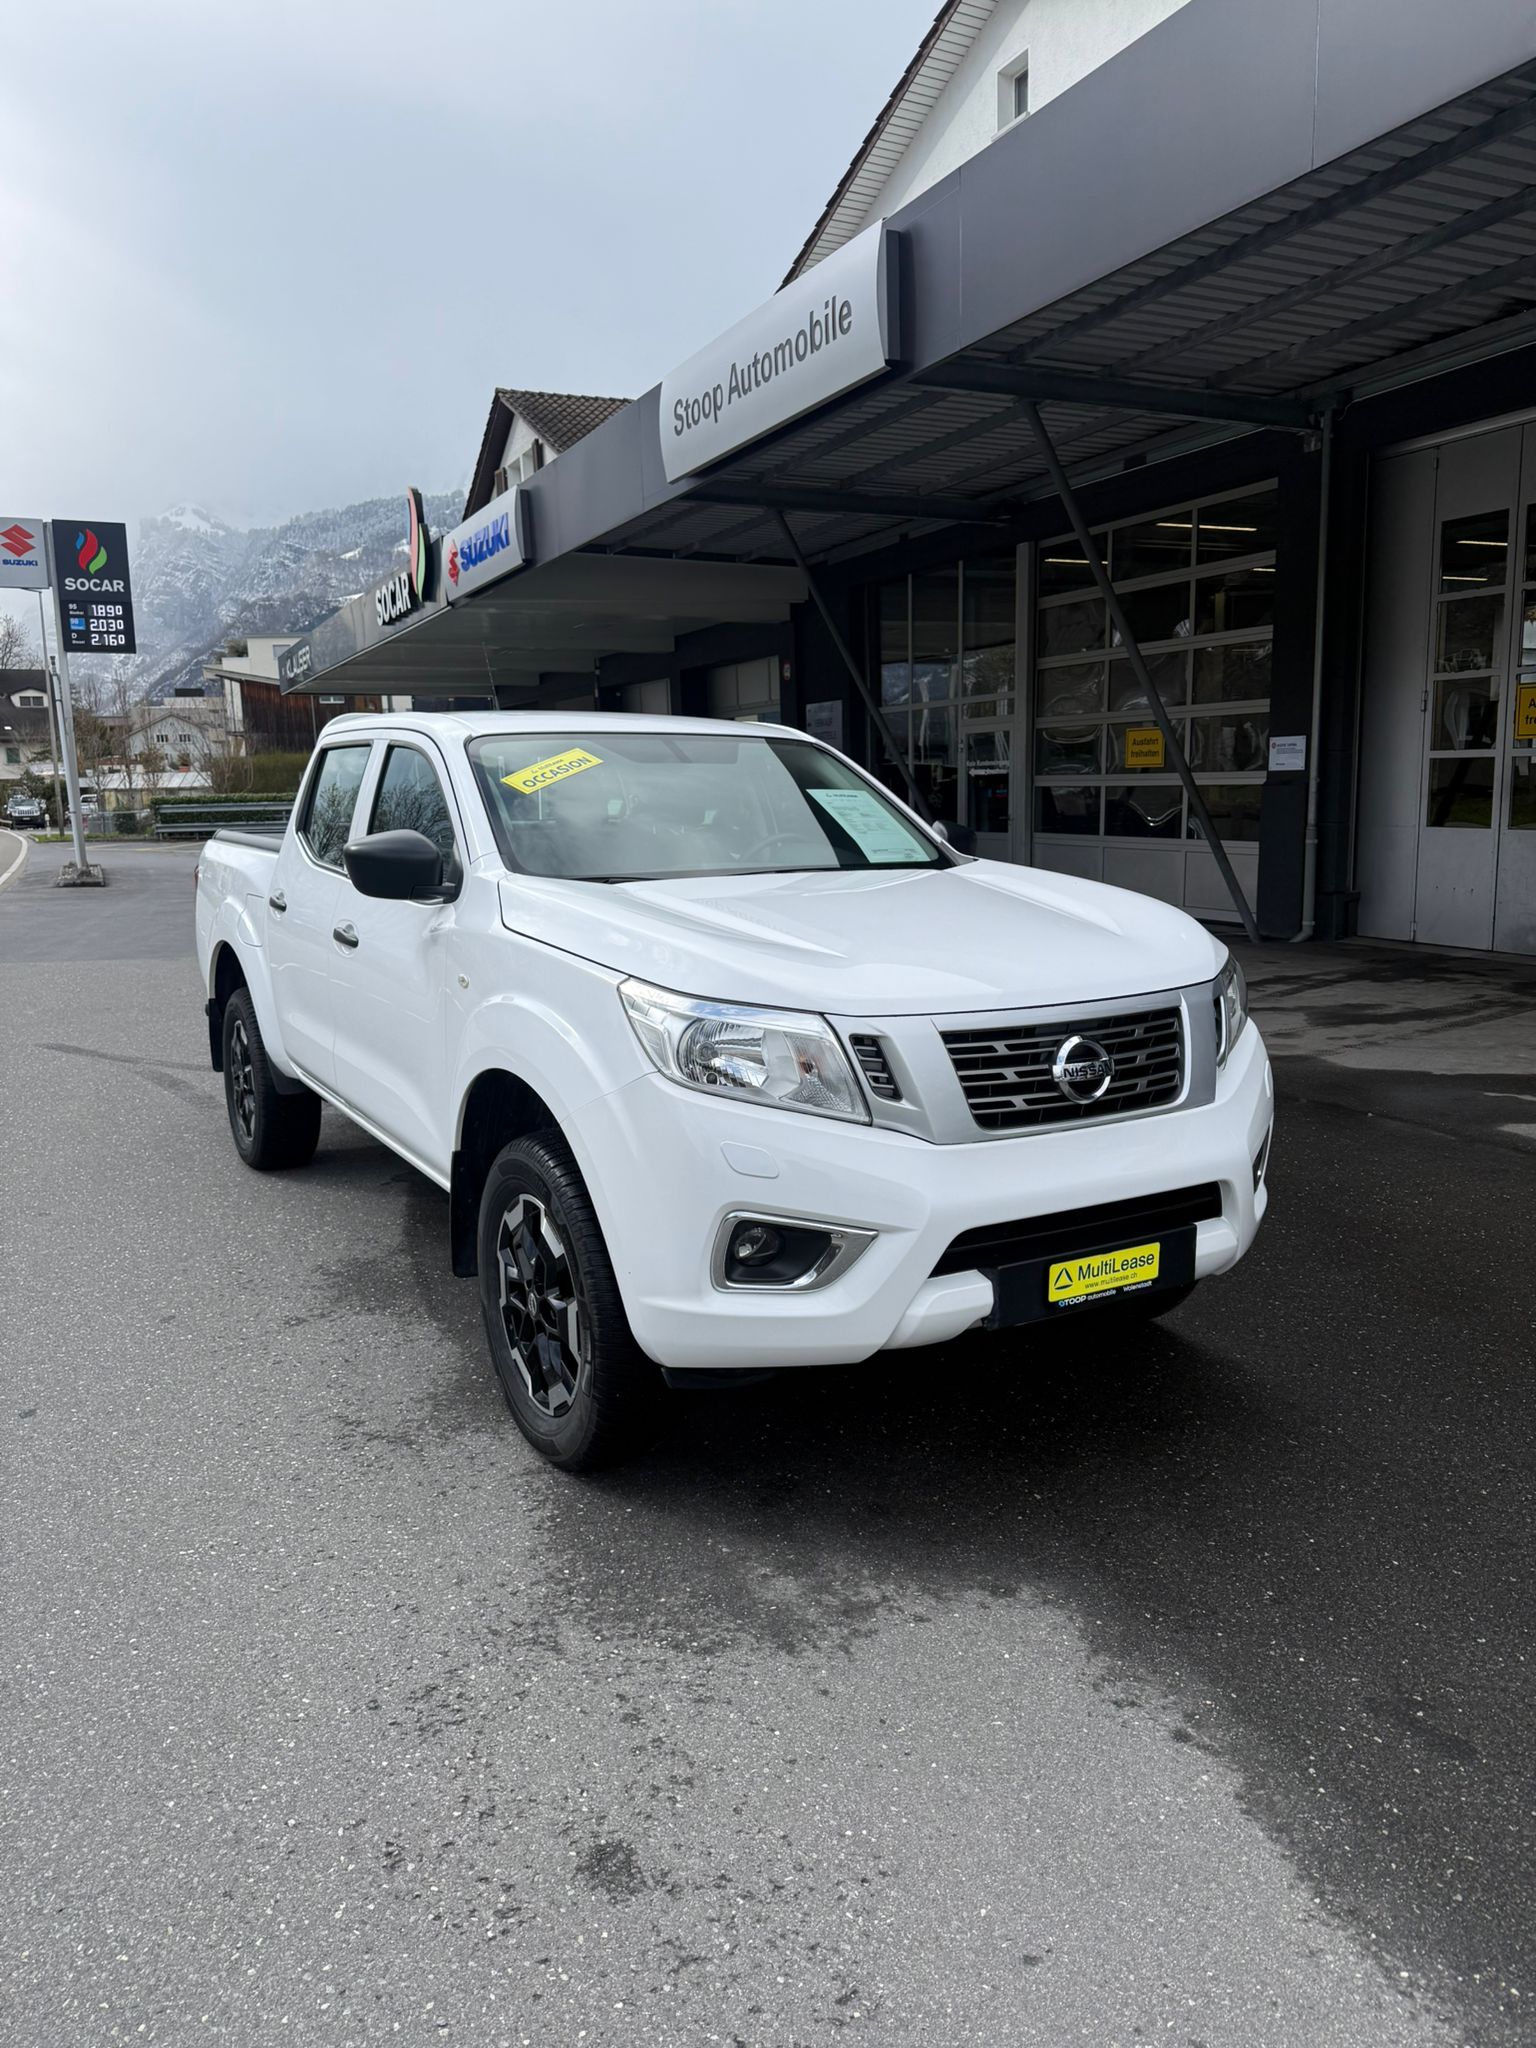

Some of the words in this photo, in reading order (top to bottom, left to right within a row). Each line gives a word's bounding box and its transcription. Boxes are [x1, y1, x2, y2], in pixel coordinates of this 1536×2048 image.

[673, 383, 724, 437] Stoop
[727, 295, 853, 406] Automobile
[460, 512, 510, 573] SUZUKI
[2, 559, 38, 567] SUZUKI
[64, 577, 125, 592] SOCAR
[375, 571, 412, 627] SOCAR
[1132, 737, 1159, 746] Ausfahrt
[522, 756, 593, 788] OCCASION
[1063, 1060, 1112, 1079] NISSAN
[1077, 1253, 1155, 1281] MultiLease
